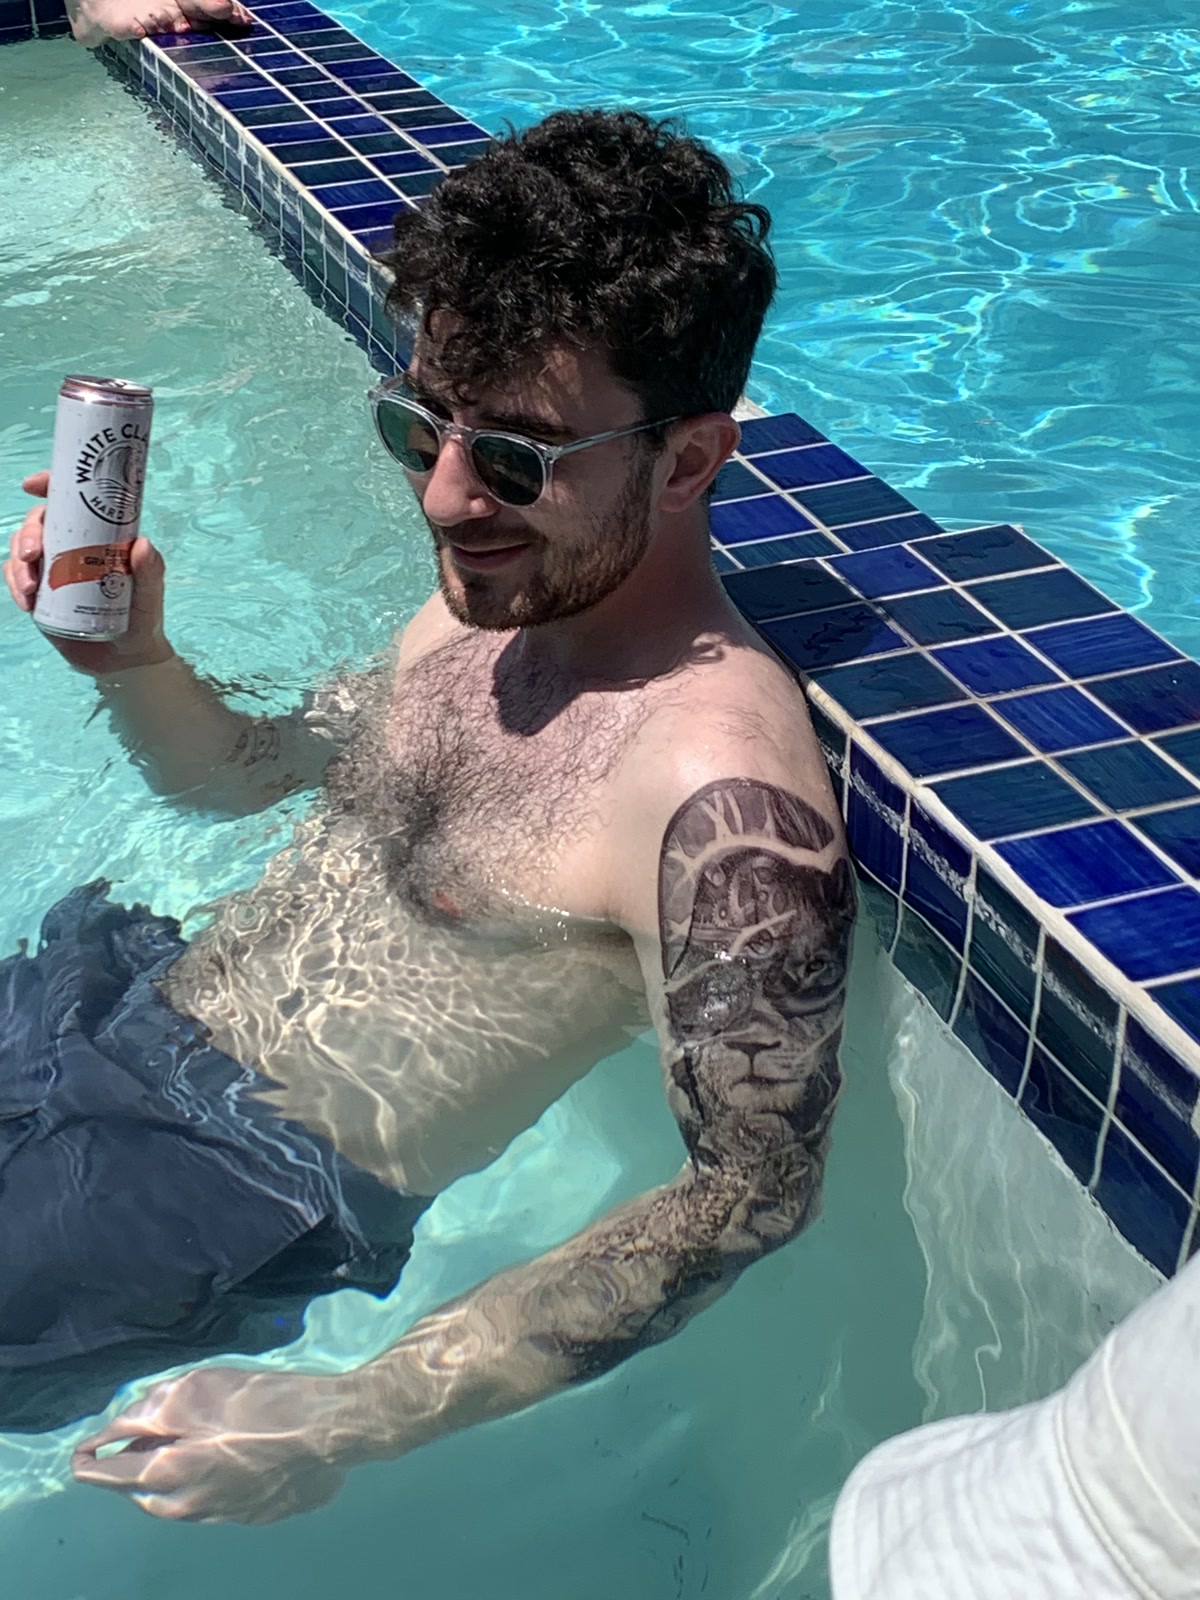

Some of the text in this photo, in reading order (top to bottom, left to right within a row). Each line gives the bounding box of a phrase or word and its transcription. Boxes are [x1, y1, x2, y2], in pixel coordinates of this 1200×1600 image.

[76, 423, 148, 483] WHITE CLA
[90, 496, 125, 520] HARD
